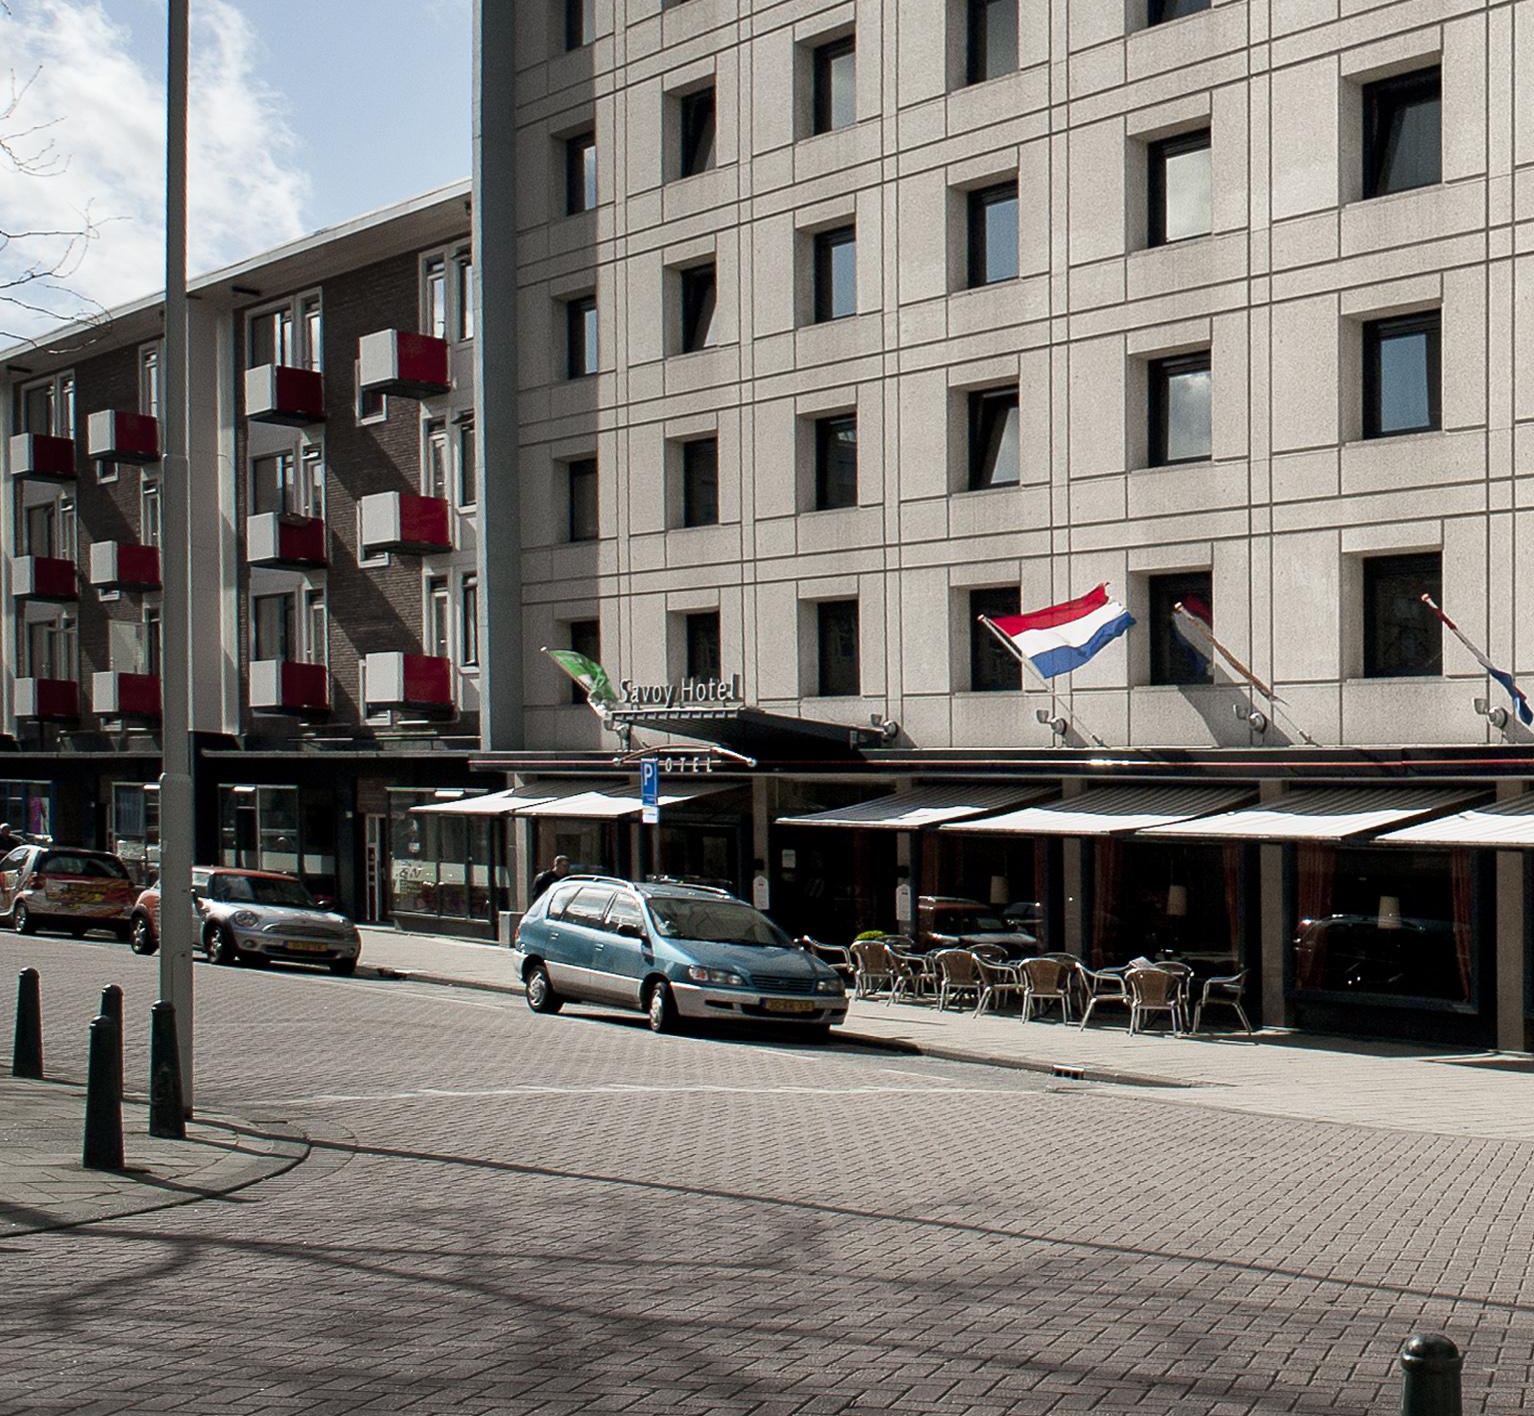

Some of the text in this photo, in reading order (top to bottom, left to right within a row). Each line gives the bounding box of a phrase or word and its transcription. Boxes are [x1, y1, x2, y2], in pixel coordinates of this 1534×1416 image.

[618, 673, 736, 708] Savoy Hotel
[643, 762, 653, 786] P
[664, 756, 713, 773] OTEL
